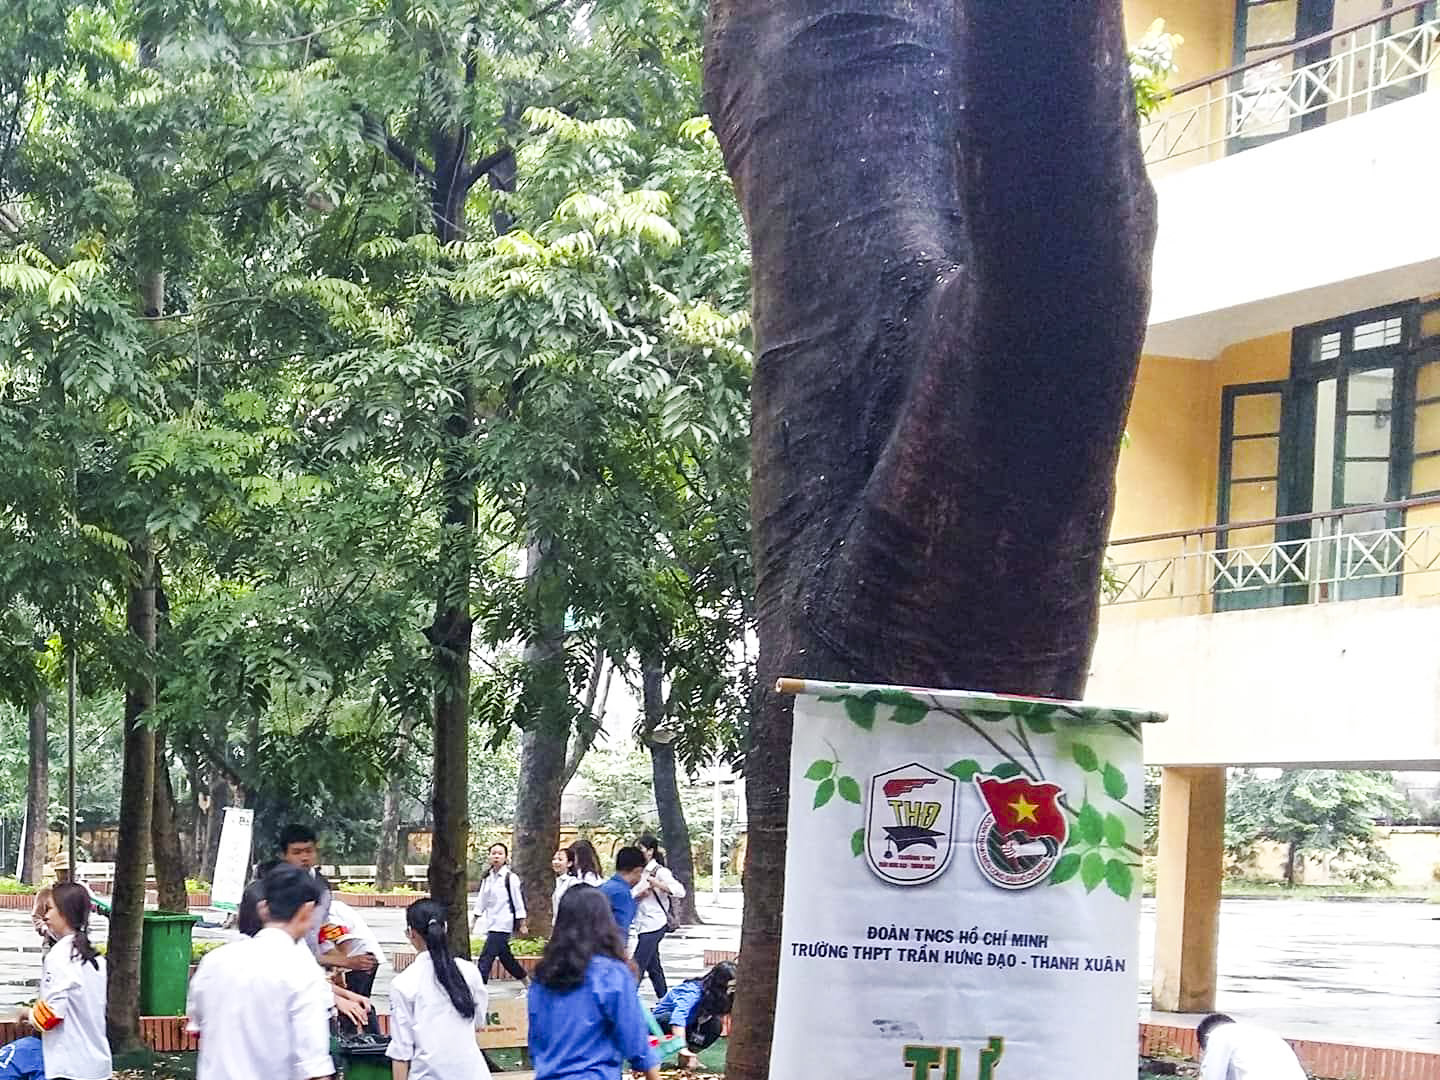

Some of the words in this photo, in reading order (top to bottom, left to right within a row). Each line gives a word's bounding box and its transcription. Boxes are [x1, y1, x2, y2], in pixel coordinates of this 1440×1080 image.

[867, 924, 910, 942] ĐOÀN
[914, 928, 955, 944] TNCS
[983, 929, 1008, 946] CHÍ
[1011, 933, 1049, 949] MINH
[791, 940, 849, 959] TRƯỜNG
[852, 945, 892, 961] THPT
[944, 948, 983, 967] HƯNG
[987, 952, 1017, 970] ĐẠO
[1030, 954, 1080, 971] THANH
[1084, 955, 1127, 972] XUÂN
